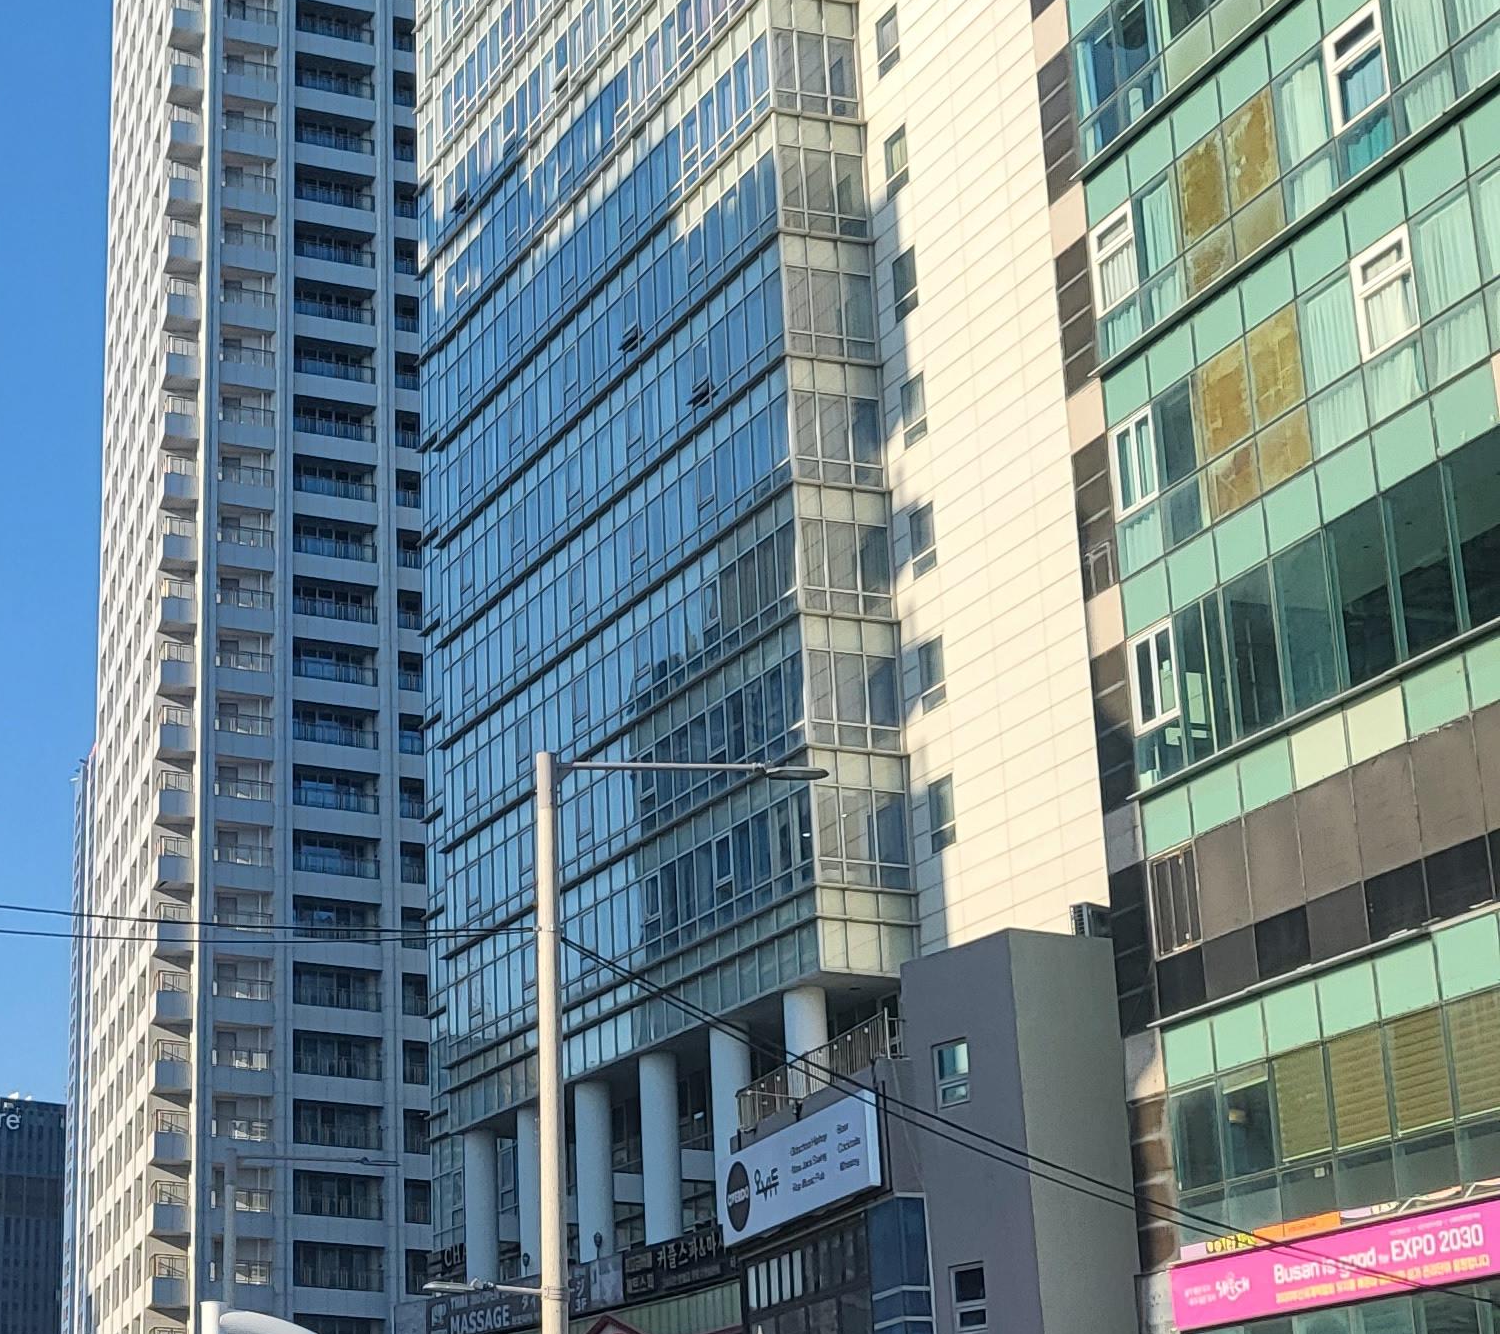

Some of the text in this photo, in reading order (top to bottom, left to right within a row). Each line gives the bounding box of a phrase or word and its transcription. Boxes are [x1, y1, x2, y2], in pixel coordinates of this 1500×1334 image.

[444, 1242, 467, 1268] CH
[1274, 1261, 1320, 1285] Busan
[1390, 1233, 1435, 1262] EXPO
[1439, 1224, 1484, 1252] 2030
